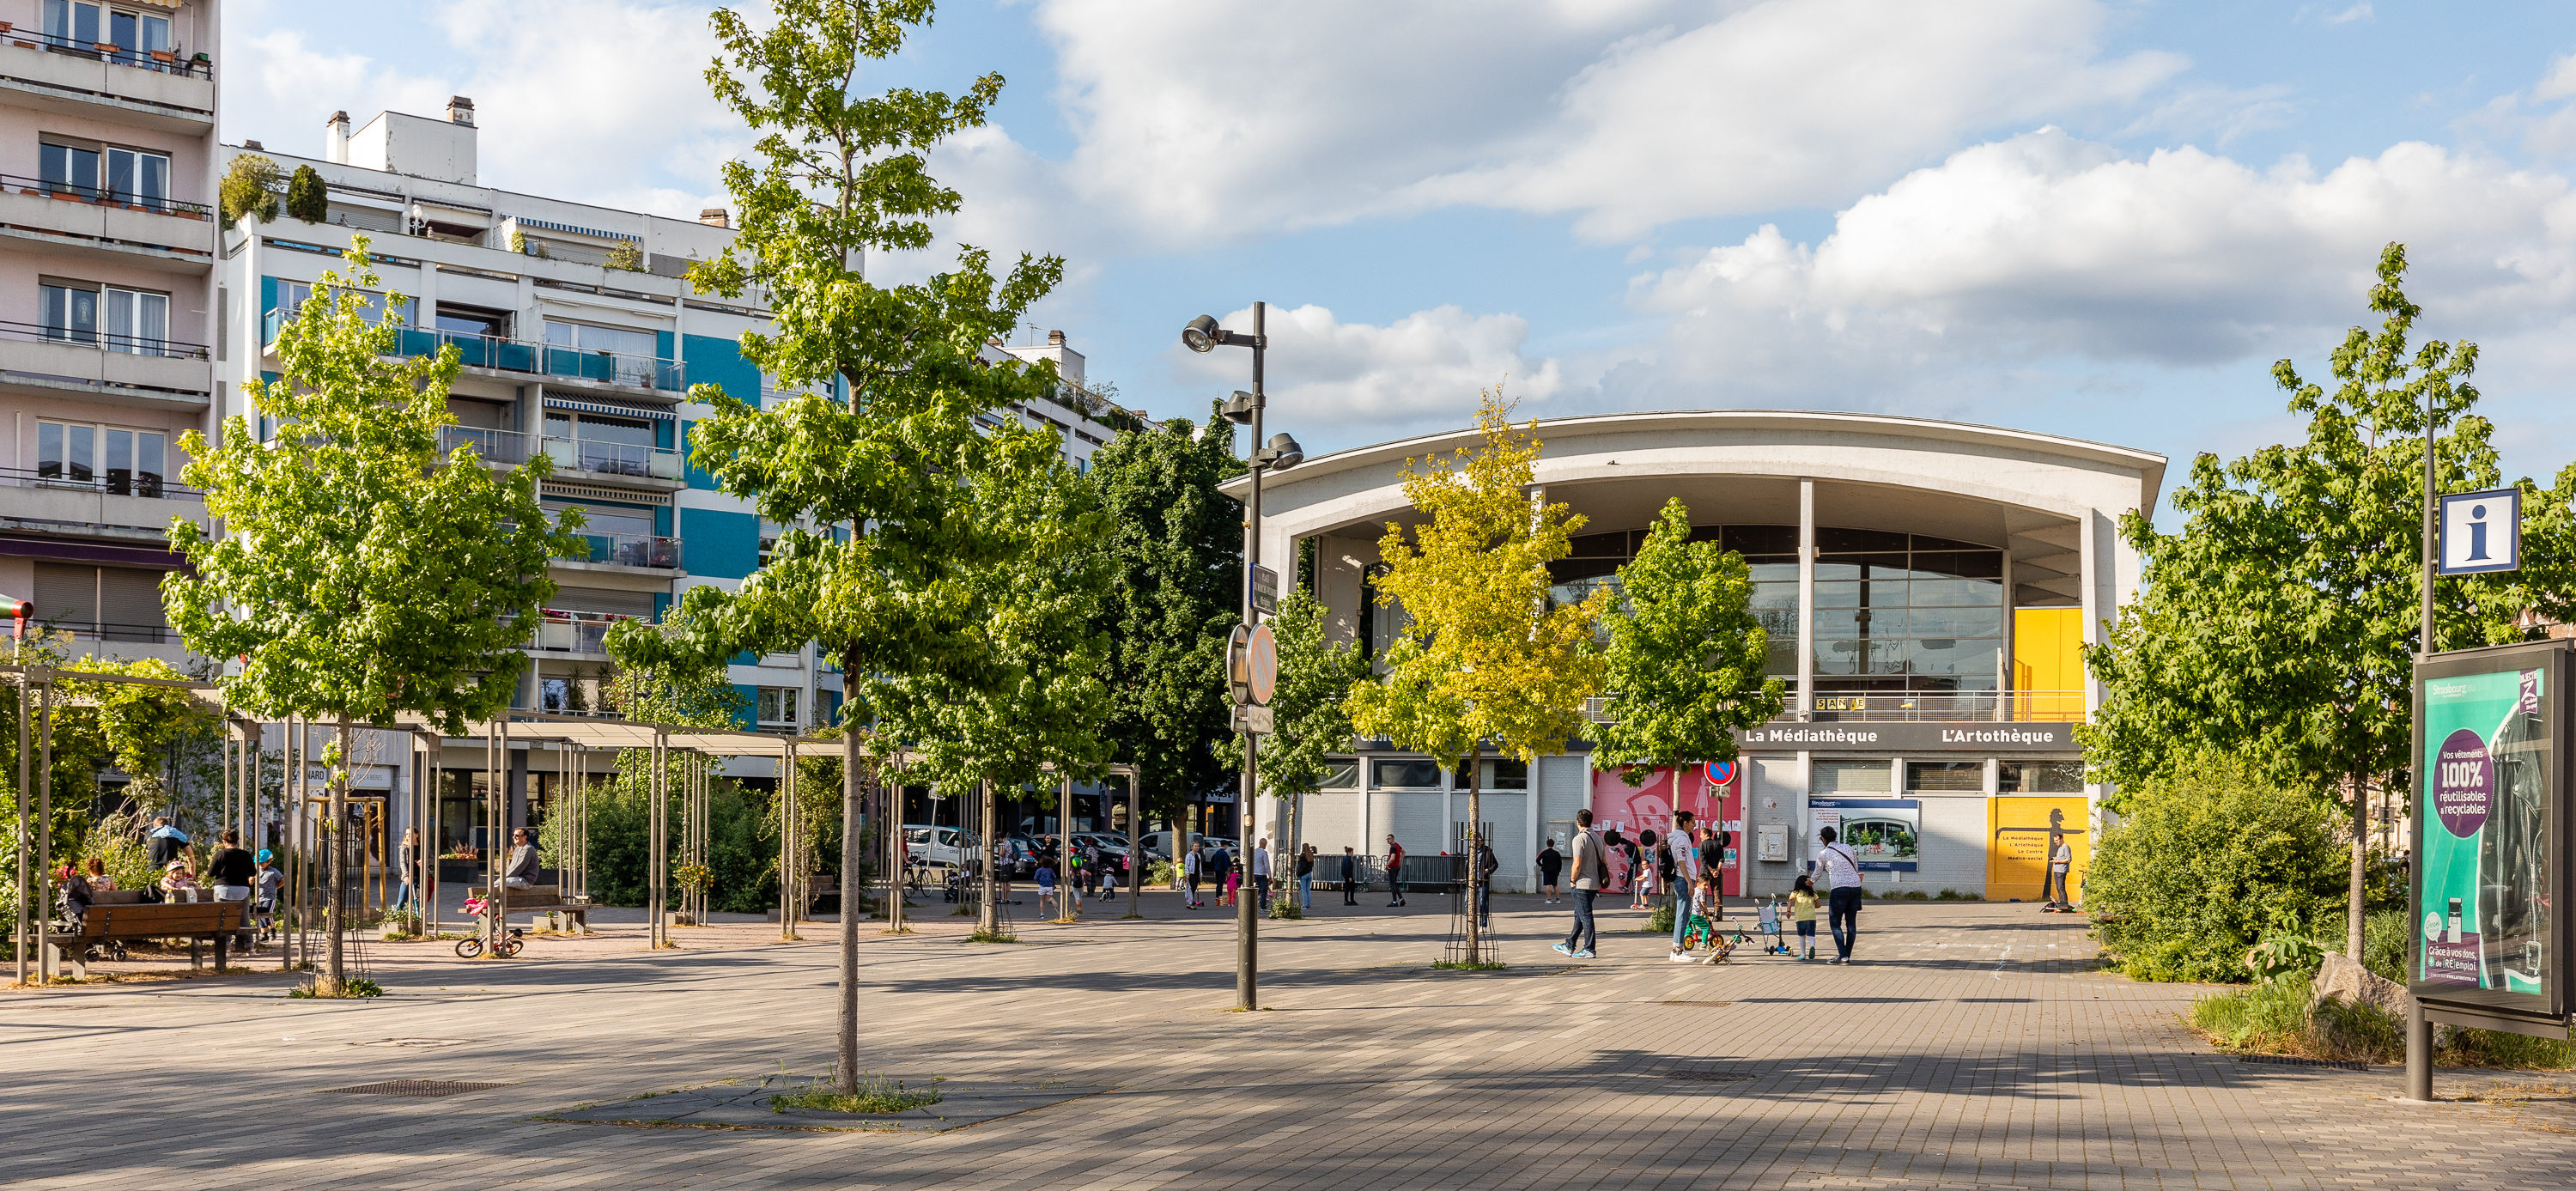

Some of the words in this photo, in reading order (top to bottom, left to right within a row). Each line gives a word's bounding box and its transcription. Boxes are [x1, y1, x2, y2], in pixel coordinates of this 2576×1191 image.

[1746, 729, 1766, 743] La
[1770, 727, 1878, 744] Médiathèque
[1941, 728, 2054, 744] L'Artothèque
[2443, 750, 2454, 759] Vos
[2455, 750, 2483, 759] vêtements
[2441, 761, 2483, 788] 100%
[2439, 790, 2486, 802] réutilisables
[2445, 803, 2486, 816] recyclables
[2428, 945, 2445, 957] Grâce
[2446, 947, 2451, 957] à
[2451, 949, 2462, 958] vos
[2463, 949, 2476, 961] dons,
